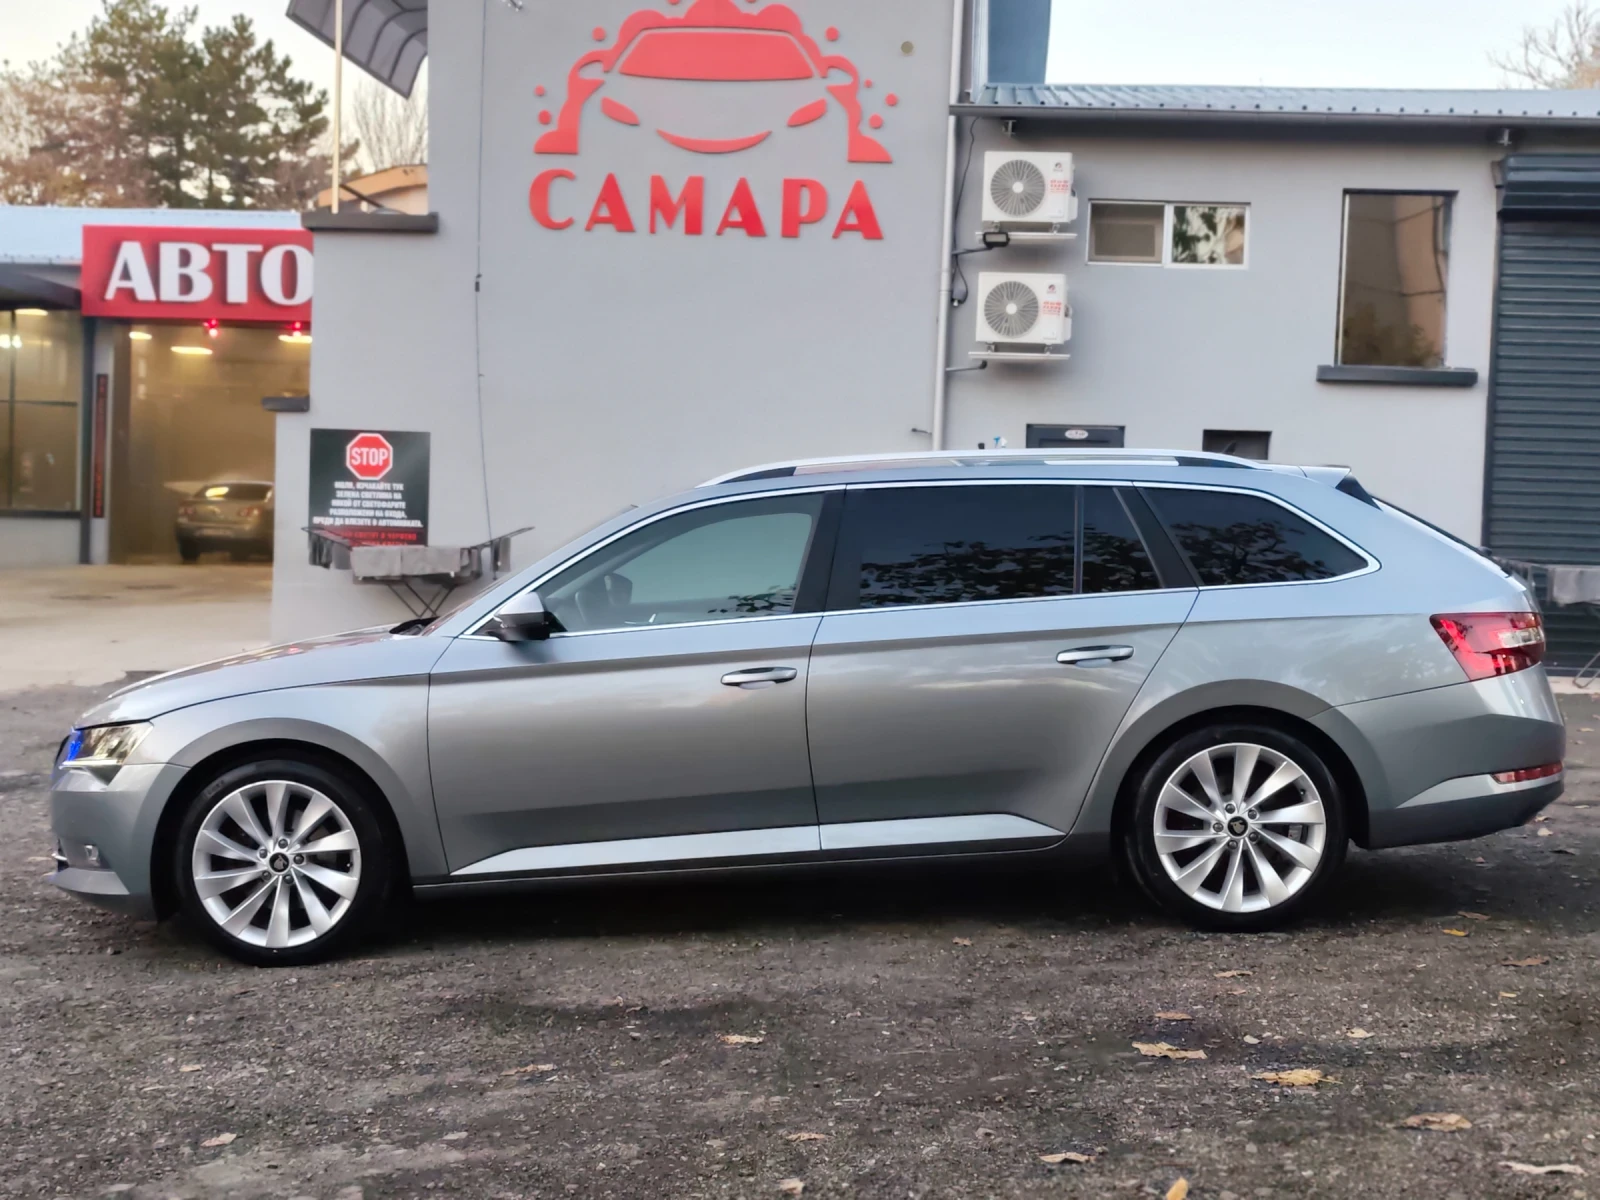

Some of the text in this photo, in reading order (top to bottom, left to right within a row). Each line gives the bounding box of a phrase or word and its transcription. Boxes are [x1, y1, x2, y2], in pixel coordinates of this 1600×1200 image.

[529, 169, 884, 240] САМАРА
[104, 241, 313, 306] АВТО
[351, 447, 388, 466] STOP
